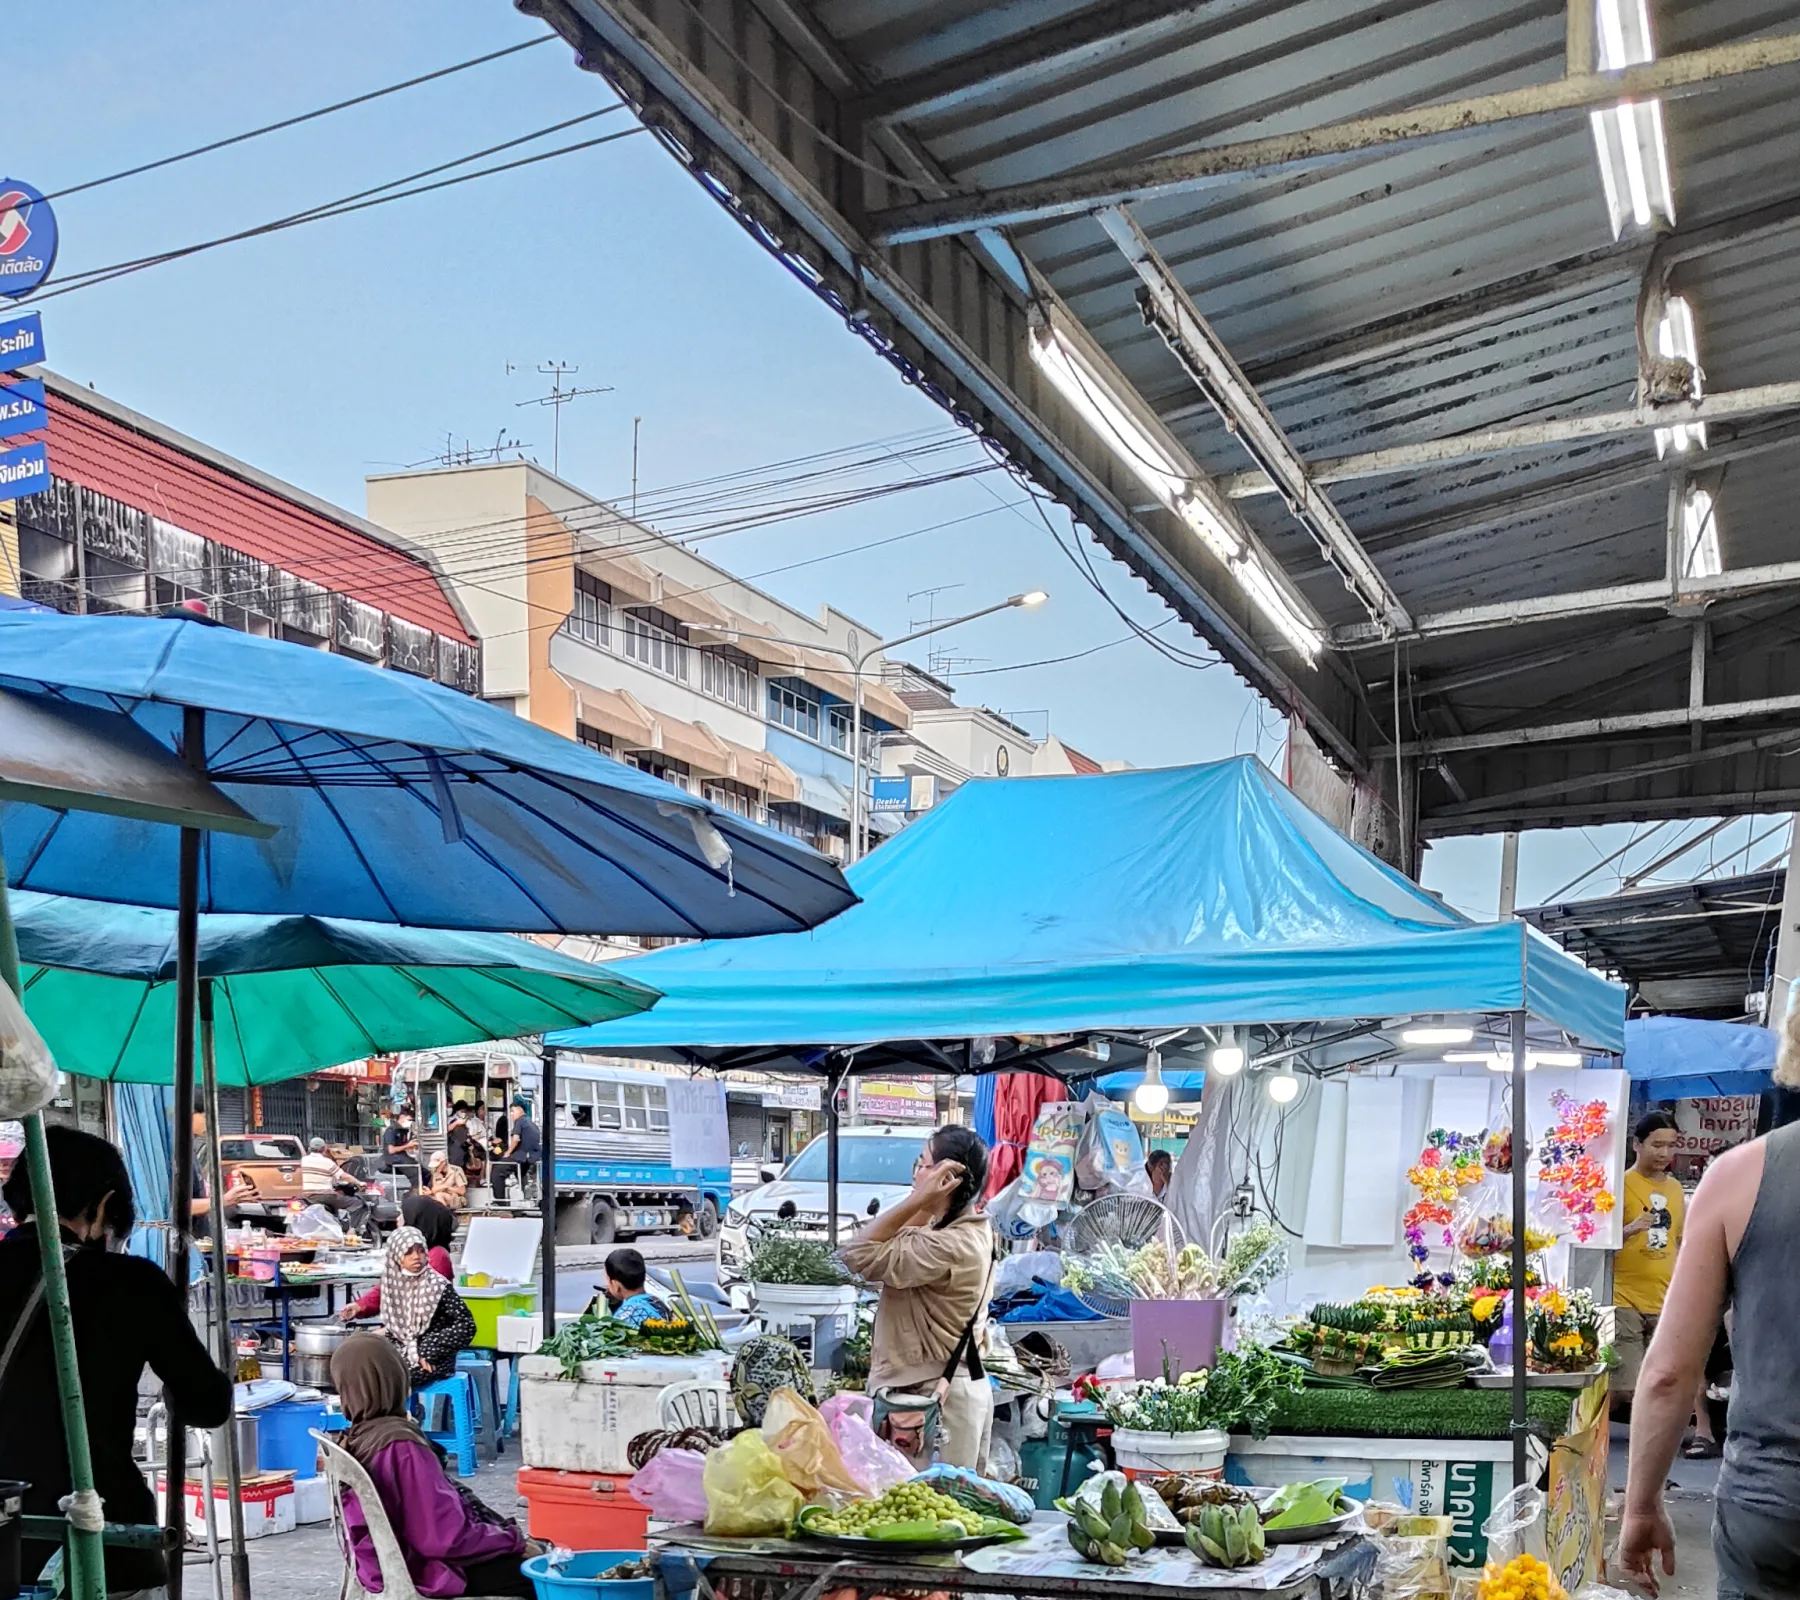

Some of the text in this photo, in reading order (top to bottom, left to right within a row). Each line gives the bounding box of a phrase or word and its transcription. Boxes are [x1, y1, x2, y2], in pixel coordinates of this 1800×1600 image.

[0, 329, 35, 354] ระกัน
[1419, 1499, 1433, 1516] จัง
[1446, 1547, 1476, 1564] 2
